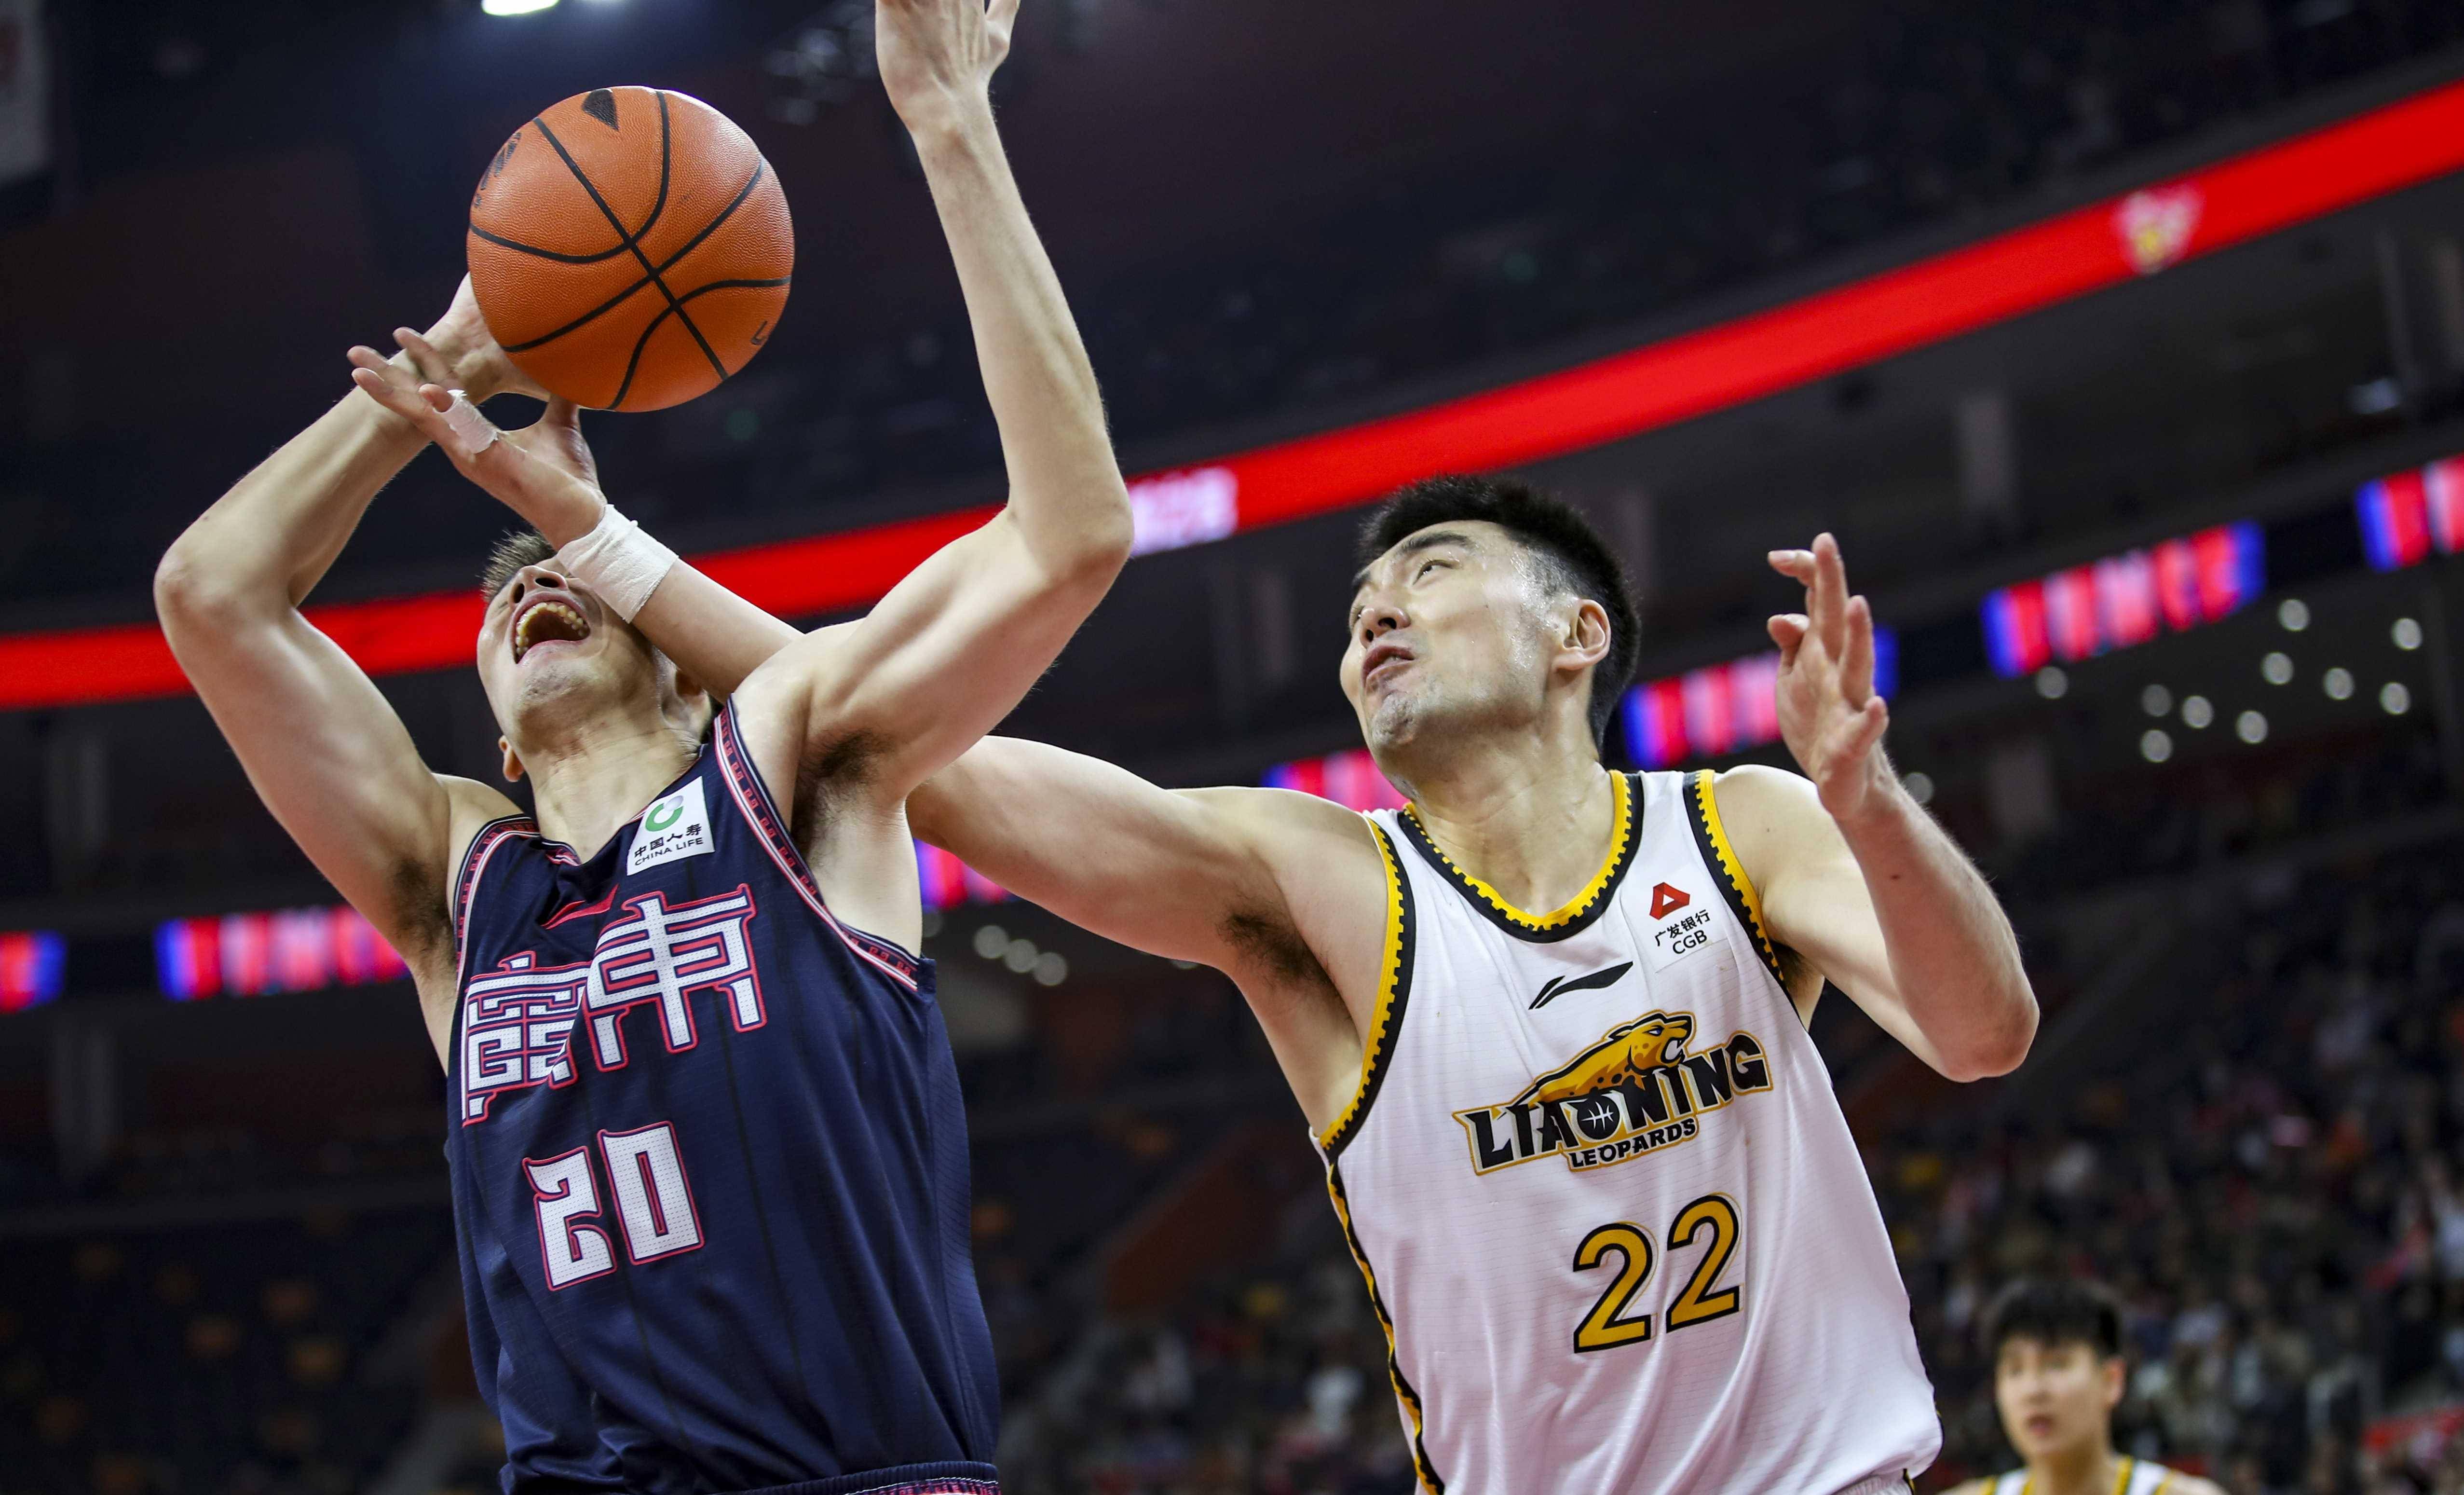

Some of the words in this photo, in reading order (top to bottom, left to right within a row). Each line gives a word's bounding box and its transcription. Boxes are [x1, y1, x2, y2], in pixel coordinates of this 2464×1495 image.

[634, 823, 702, 858] 中国人寿
[634, 847, 672, 866] CHINA
[676, 837, 704, 850] LIFE
[1654, 909, 1711, 946] 广发银行
[1672, 930, 1707, 954] CGB
[1454, 1030, 1772, 1174] LIAONING
[1568, 1117, 1696, 1168] LEOPARDS
[521, 1120, 705, 1291] 20
[1573, 1192, 1744, 1354] 22
